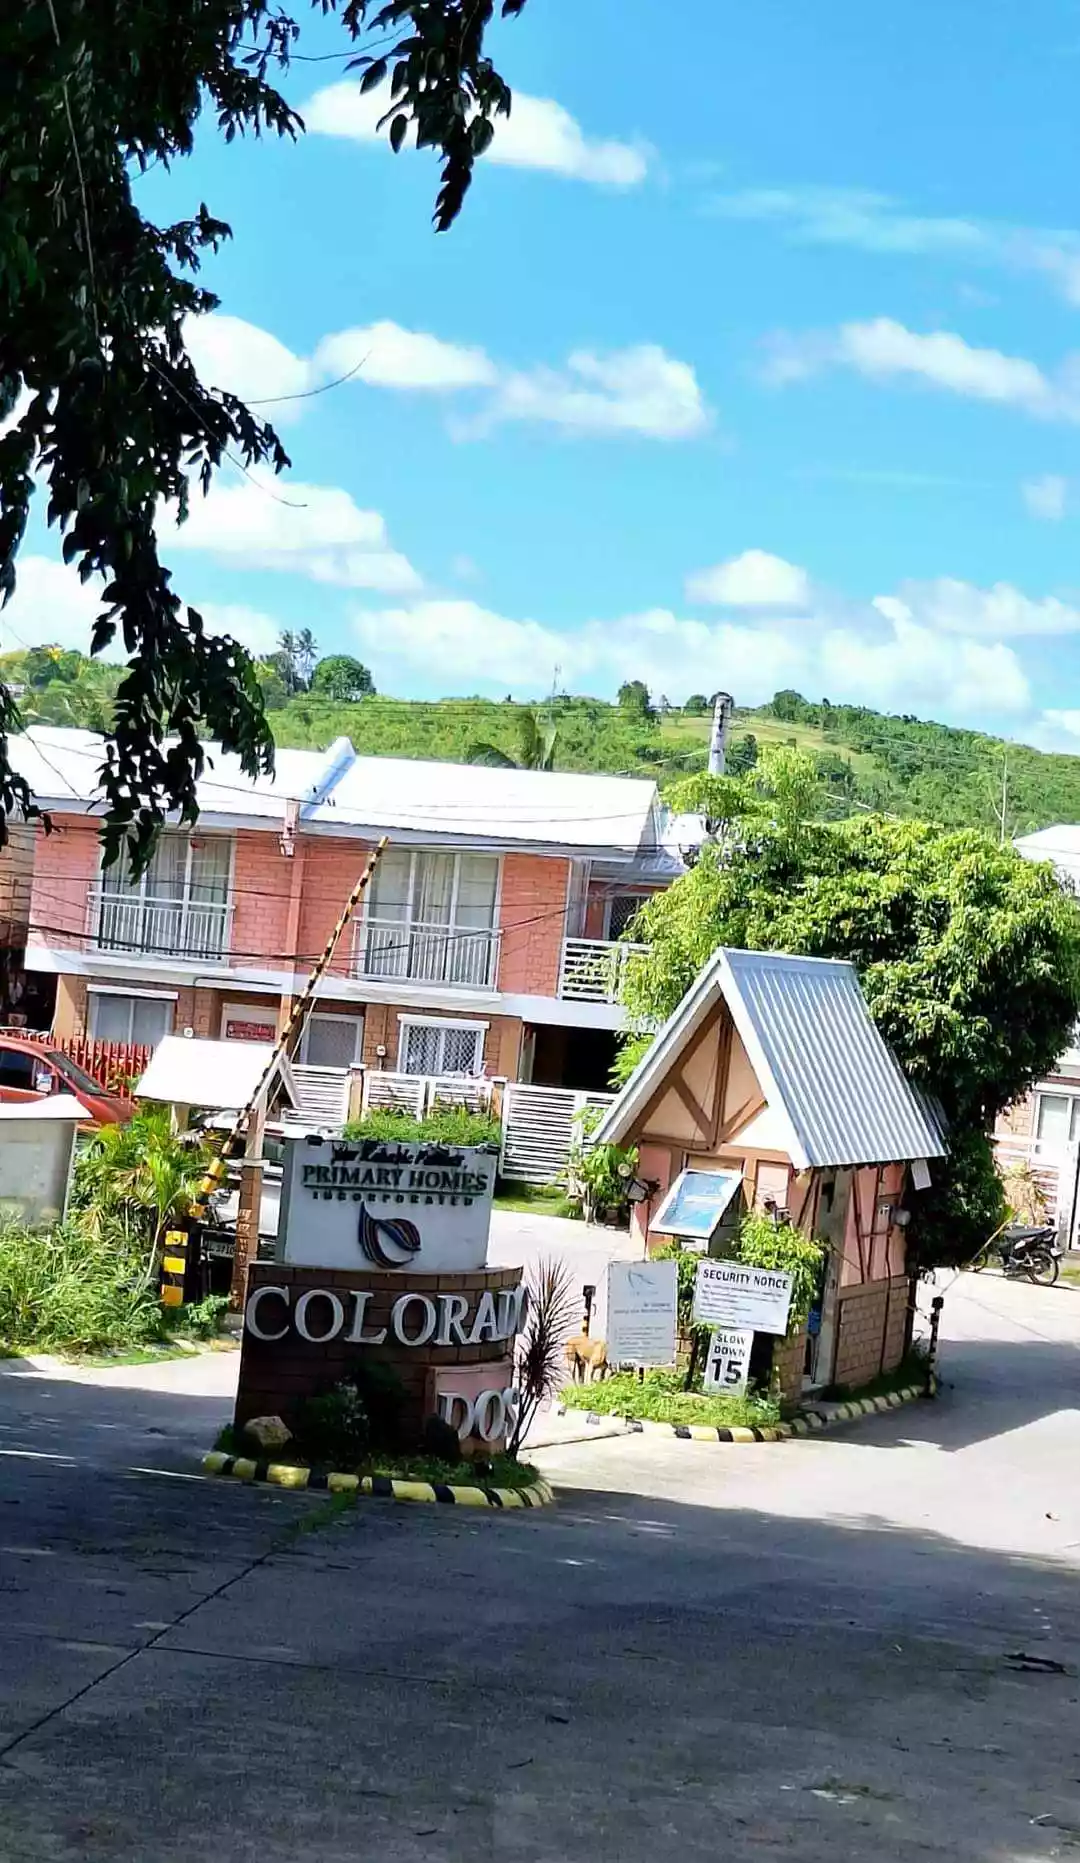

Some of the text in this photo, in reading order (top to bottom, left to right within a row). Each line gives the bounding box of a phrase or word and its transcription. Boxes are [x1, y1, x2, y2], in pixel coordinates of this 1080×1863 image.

[302, 1164, 488, 1191] PRIMARY HOMES
[312, 1190, 474, 1207] INCORPORATED
[703, 1268, 789, 1290] SECURITY NOTICE
[716, 1333, 746, 1345] SLOW
[713, 1345, 746, 1357] DOWN
[711, 1358, 743, 1384] 15
